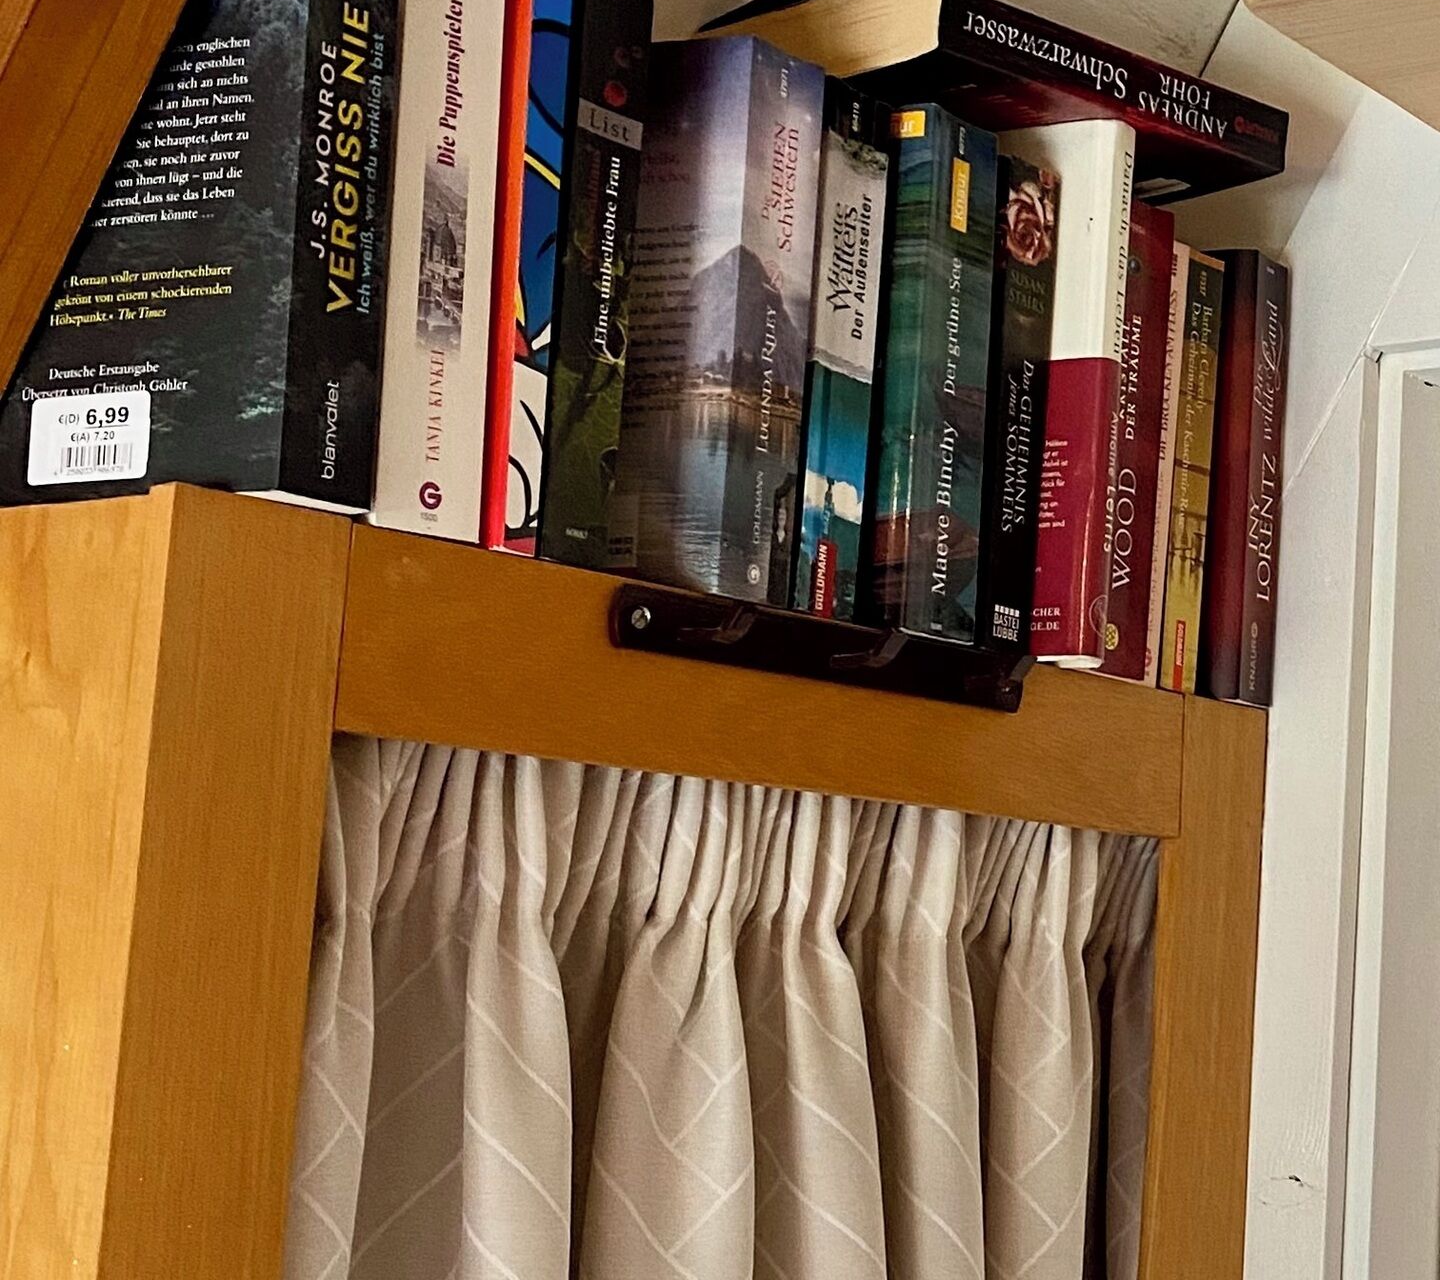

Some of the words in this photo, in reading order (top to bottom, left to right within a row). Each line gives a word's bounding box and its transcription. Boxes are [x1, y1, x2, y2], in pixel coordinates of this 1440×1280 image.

[196, 37, 251, 54] englischen
[340, 1, 371, 86] NIE
[371, 32, 386, 72] bist
[962, 10, 1129, 100] Schwarzwasser
[176, 79, 198, 92] sich
[200, 78, 213, 88] an
[216, 74, 249, 87] nichts
[195, 56, 246, 74] gestohlen
[166, 98, 179, 110] an
[181, 94, 210, 108] ihren
[193, 114, 218, 129] Jetzt
[220, 111, 246, 123] steht
[314, 39, 338, 188] MONROE
[366, 78, 384, 153] wirklich
[1138, 90, 1228, 140] ANDREAS
[210, 131, 233, 143] dort
[235, 131, 250, 142] zu
[588, 105, 632, 142] List
[143, 156, 158, 168] sie
[160, 152, 187, 165] noch
[190, 151, 207, 163] nie
[209, 149, 241, 161] zuvor
[367, 156, 379, 182] du
[436, 136, 456, 169] Die
[770, 121, 789, 210] SIEBEN
[114, 177, 134, 189] von
[136, 172, 166, 186] ihnen
[168, 169, 190, 186] lügt
[202, 167, 224, 181] und
[226, 166, 244, 179] die
[142, 191, 164, 206] dass
[165, 190, 180, 202] sie
[182, 188, 200, 201] das
[202, 185, 236, 200] Leben
[605, 156, 621, 198] Frau
[777, 128, 800, 253] Schwestern
[953, 172, 968, 223] Knaur
[1120, 151, 1134, 237] Danach,
[110, 210, 158, 227] zerstören
[160, 208, 198, 222] könnte
[326, 98, 364, 314] VERGISS
[364, 184, 377, 224] wer
[309, 200, 330, 261] J.S.
[598, 200, 618, 300] unbeliebte
[854, 193, 873, 304] Außenseiter
[70, 273, 108, 288] Roman
[110, 270, 140, 284] voller
[949, 256, 963, 290] See
[1118, 245, 1130, 281] das
[94, 292, 113, 303] von
[116, 290, 149, 302] einem
[150, 282, 233, 300] schockierenden
[117, 307, 136, 321] The
[138, 306, 168, 319] Times
[356, 279, 371, 316] Ich
[851, 308, 865, 341] Der
[946, 296, 963, 356] grüne
[1190, 301, 1202, 327] Das
[1199, 304, 1213, 356] Barbara
[49, 365, 96, 381] Deutsche
[98, 360, 161, 378] Erstausgabe
[1021, 358, 1035, 391] Das
[1128, 313, 1143, 395] TRÄUME
[1185, 329, 1201, 401] Geheimnis
[149, 378, 189, 392] Göhler
[943, 368, 957, 396] Der
[1007, 374, 1018, 418] jenes
[1195, 358, 1210, 413] Cleverly
[85, 406, 130, 429] 6,99
[320, 379, 341, 481] blanvalet
[756, 371, 775, 454] LUCINDA
[1125, 415, 1136, 441] DER
[1184, 403, 1196, 425] der
[425, 413, 443, 463] TANJA
[1107, 411, 1119, 478] Antoine
[936, 420, 960, 508] Binchy
[1001, 424, 1017, 534] SOMMERS
[1013, 401, 1034, 527] GEHEIMNIS
[1111, 467, 1138, 592] WOOD
[1247, 492, 1259, 552] INY
[1256, 452, 1277, 602] LORENTZ
[931, 514, 952, 596] Maeve
[814, 543, 828, 611] GOLDMANN
[993, 612, 1020, 630] BASTEI
[1031, 607, 1061, 617] CHER
[1248, 638, 1258, 691] KNAUR
